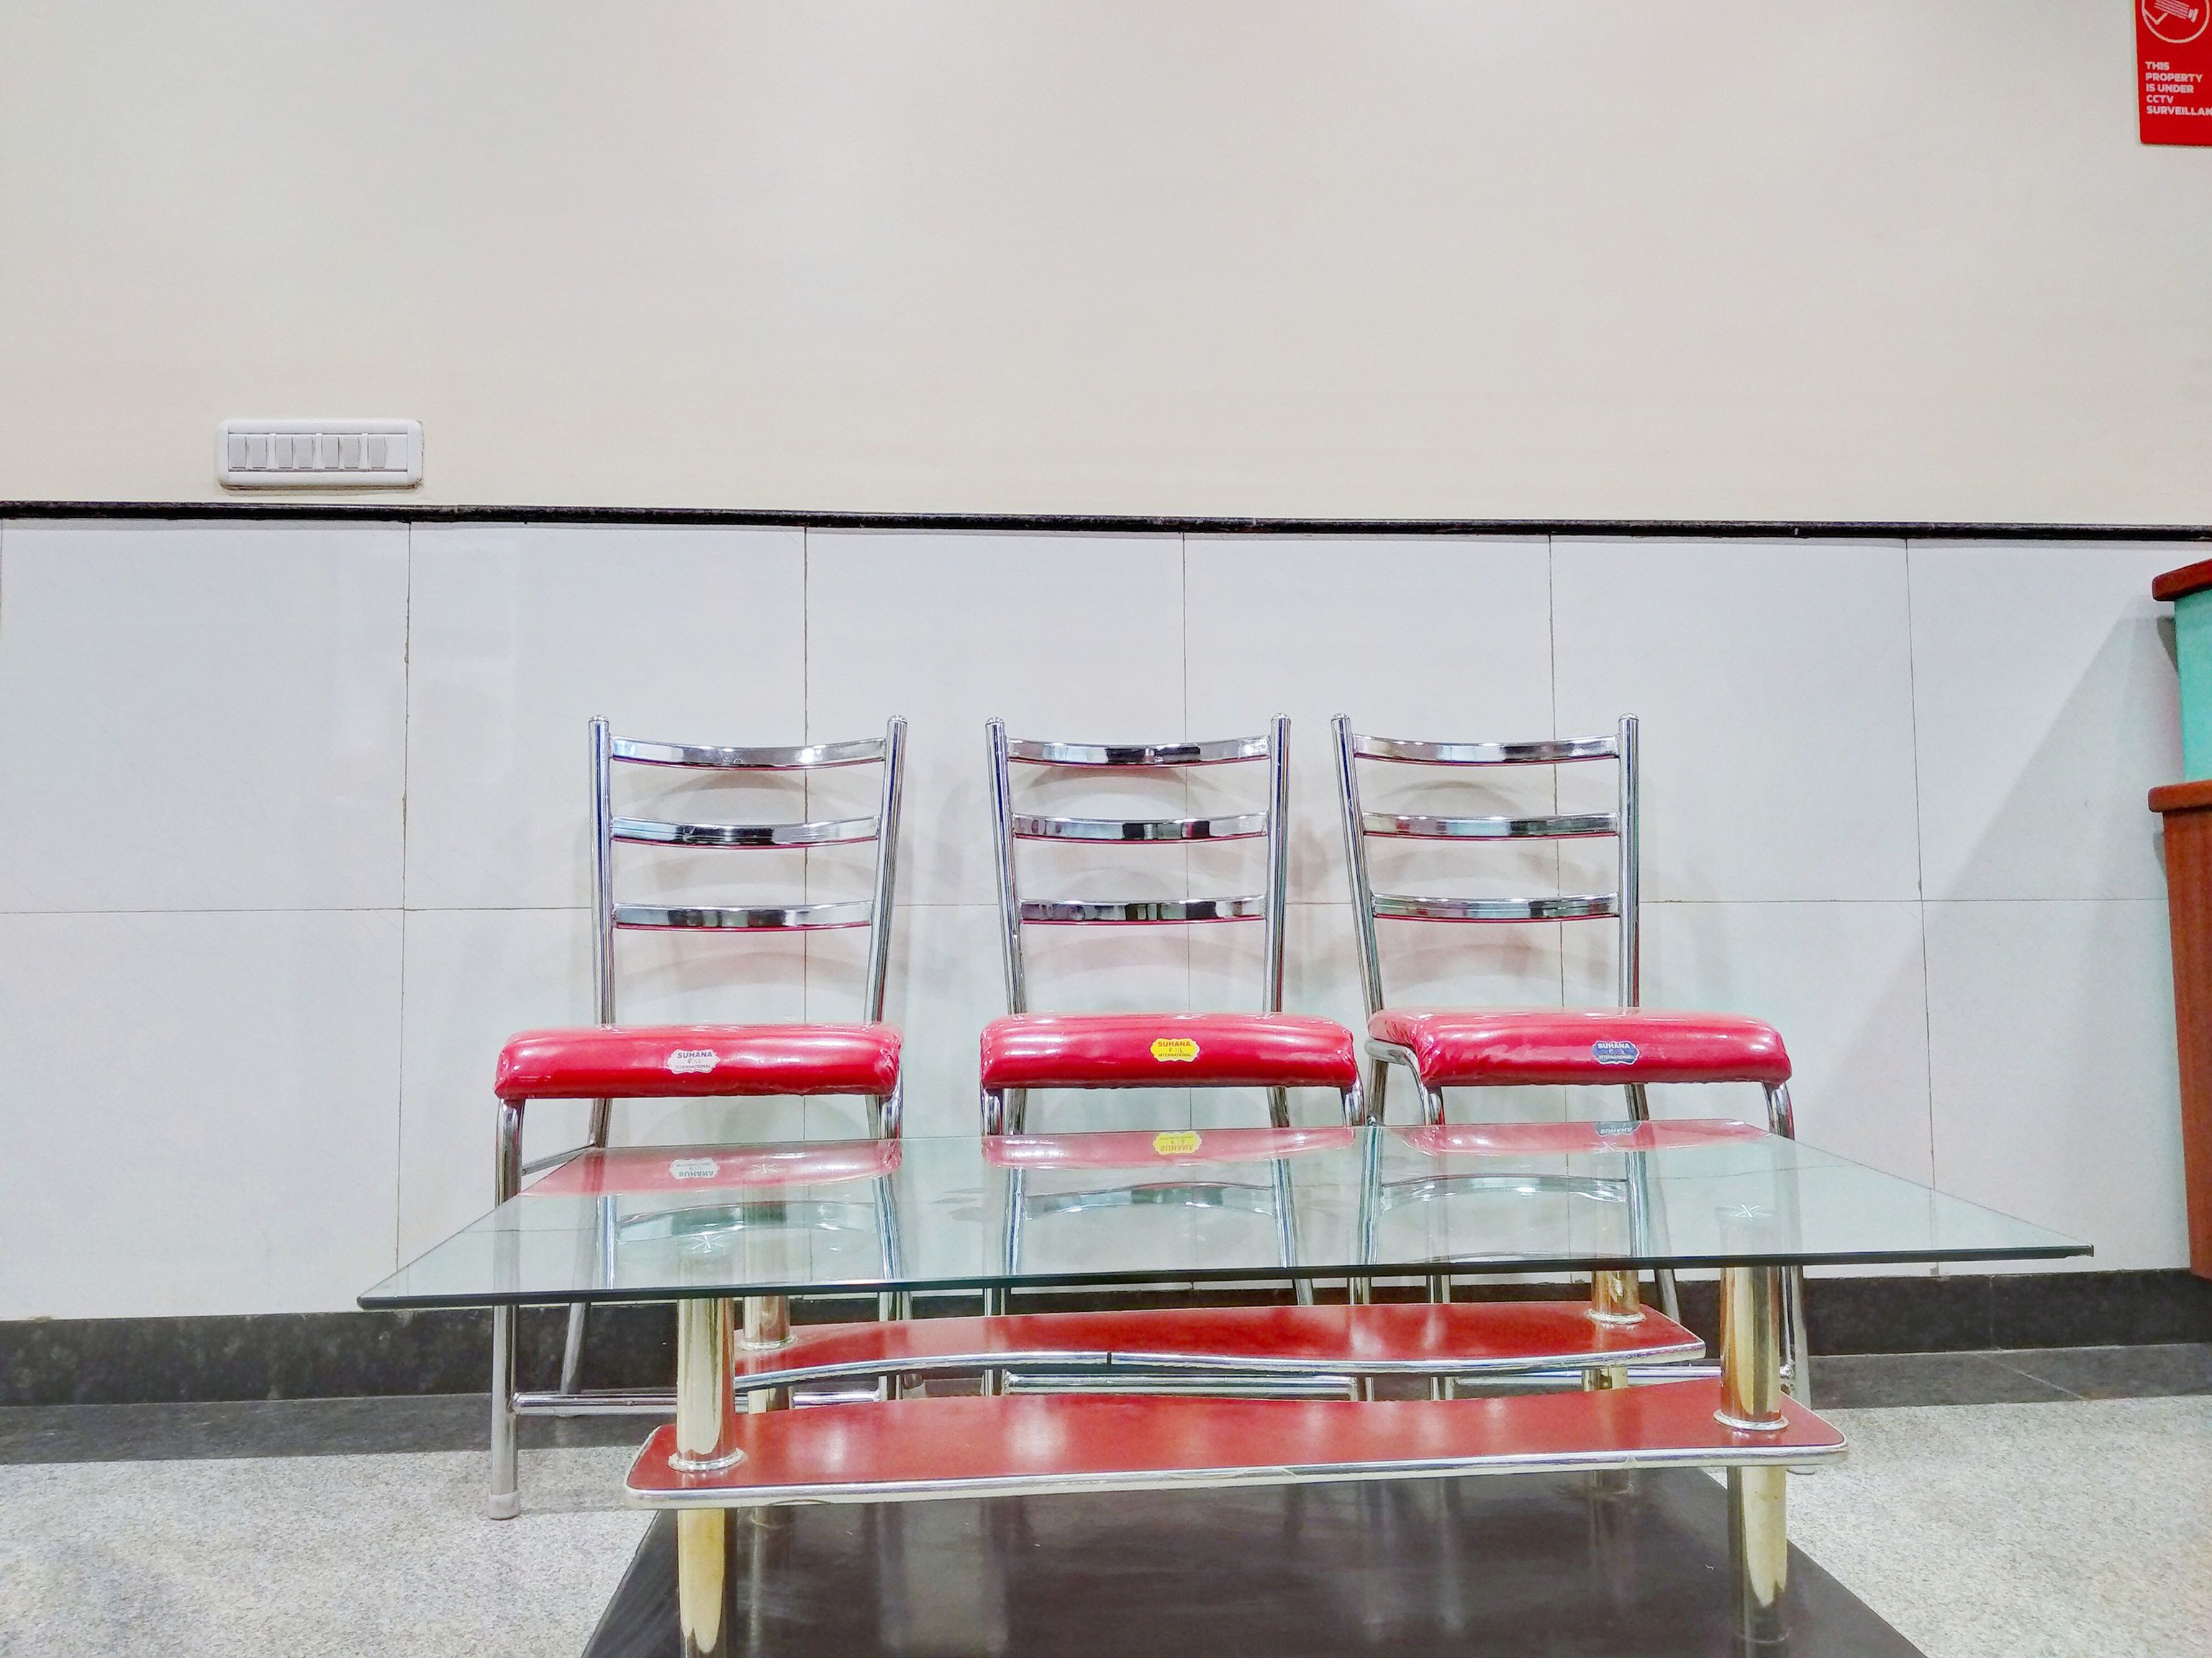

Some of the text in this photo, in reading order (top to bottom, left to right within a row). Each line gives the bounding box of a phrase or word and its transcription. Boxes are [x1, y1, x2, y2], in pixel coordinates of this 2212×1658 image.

[2145, 61, 2170, 71] THIS
[2145, 73, 2203, 83] PROPERTY
[2146, 83, 2195, 94] IS UNDER
[2146, 94, 2175, 104] CCTV
